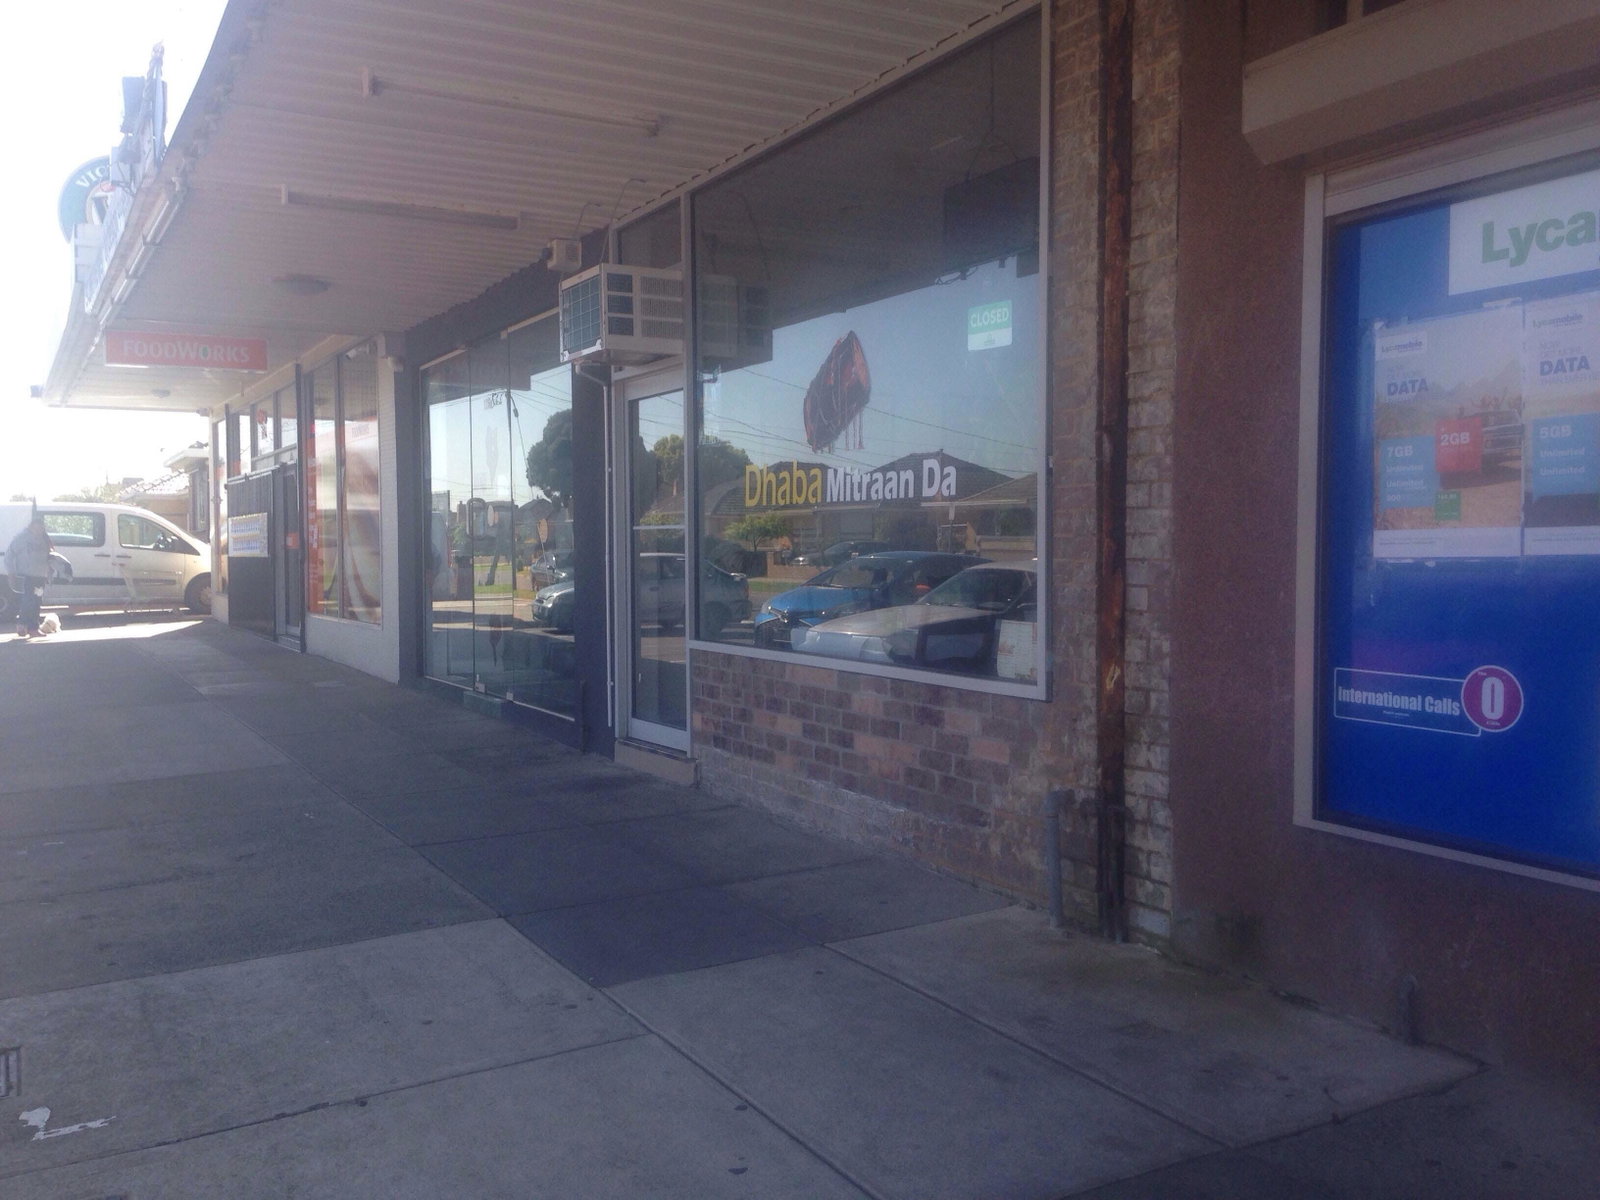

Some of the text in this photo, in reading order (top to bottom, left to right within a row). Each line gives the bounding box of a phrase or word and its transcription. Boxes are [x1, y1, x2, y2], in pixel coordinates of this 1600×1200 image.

[970, 307, 1009, 328] CLOSED
[1540, 355, 1590, 376] DATA
[1387, 378, 1429, 396] DATA
[1440, 432, 1470, 446] 2GB
[1387, 445, 1413, 458] 7GB
[745, 458, 957, 507] Dhaba Mitraan Da
[1338, 686, 1460, 716] International Calls
[1481, 676, 1504, 720] 0
